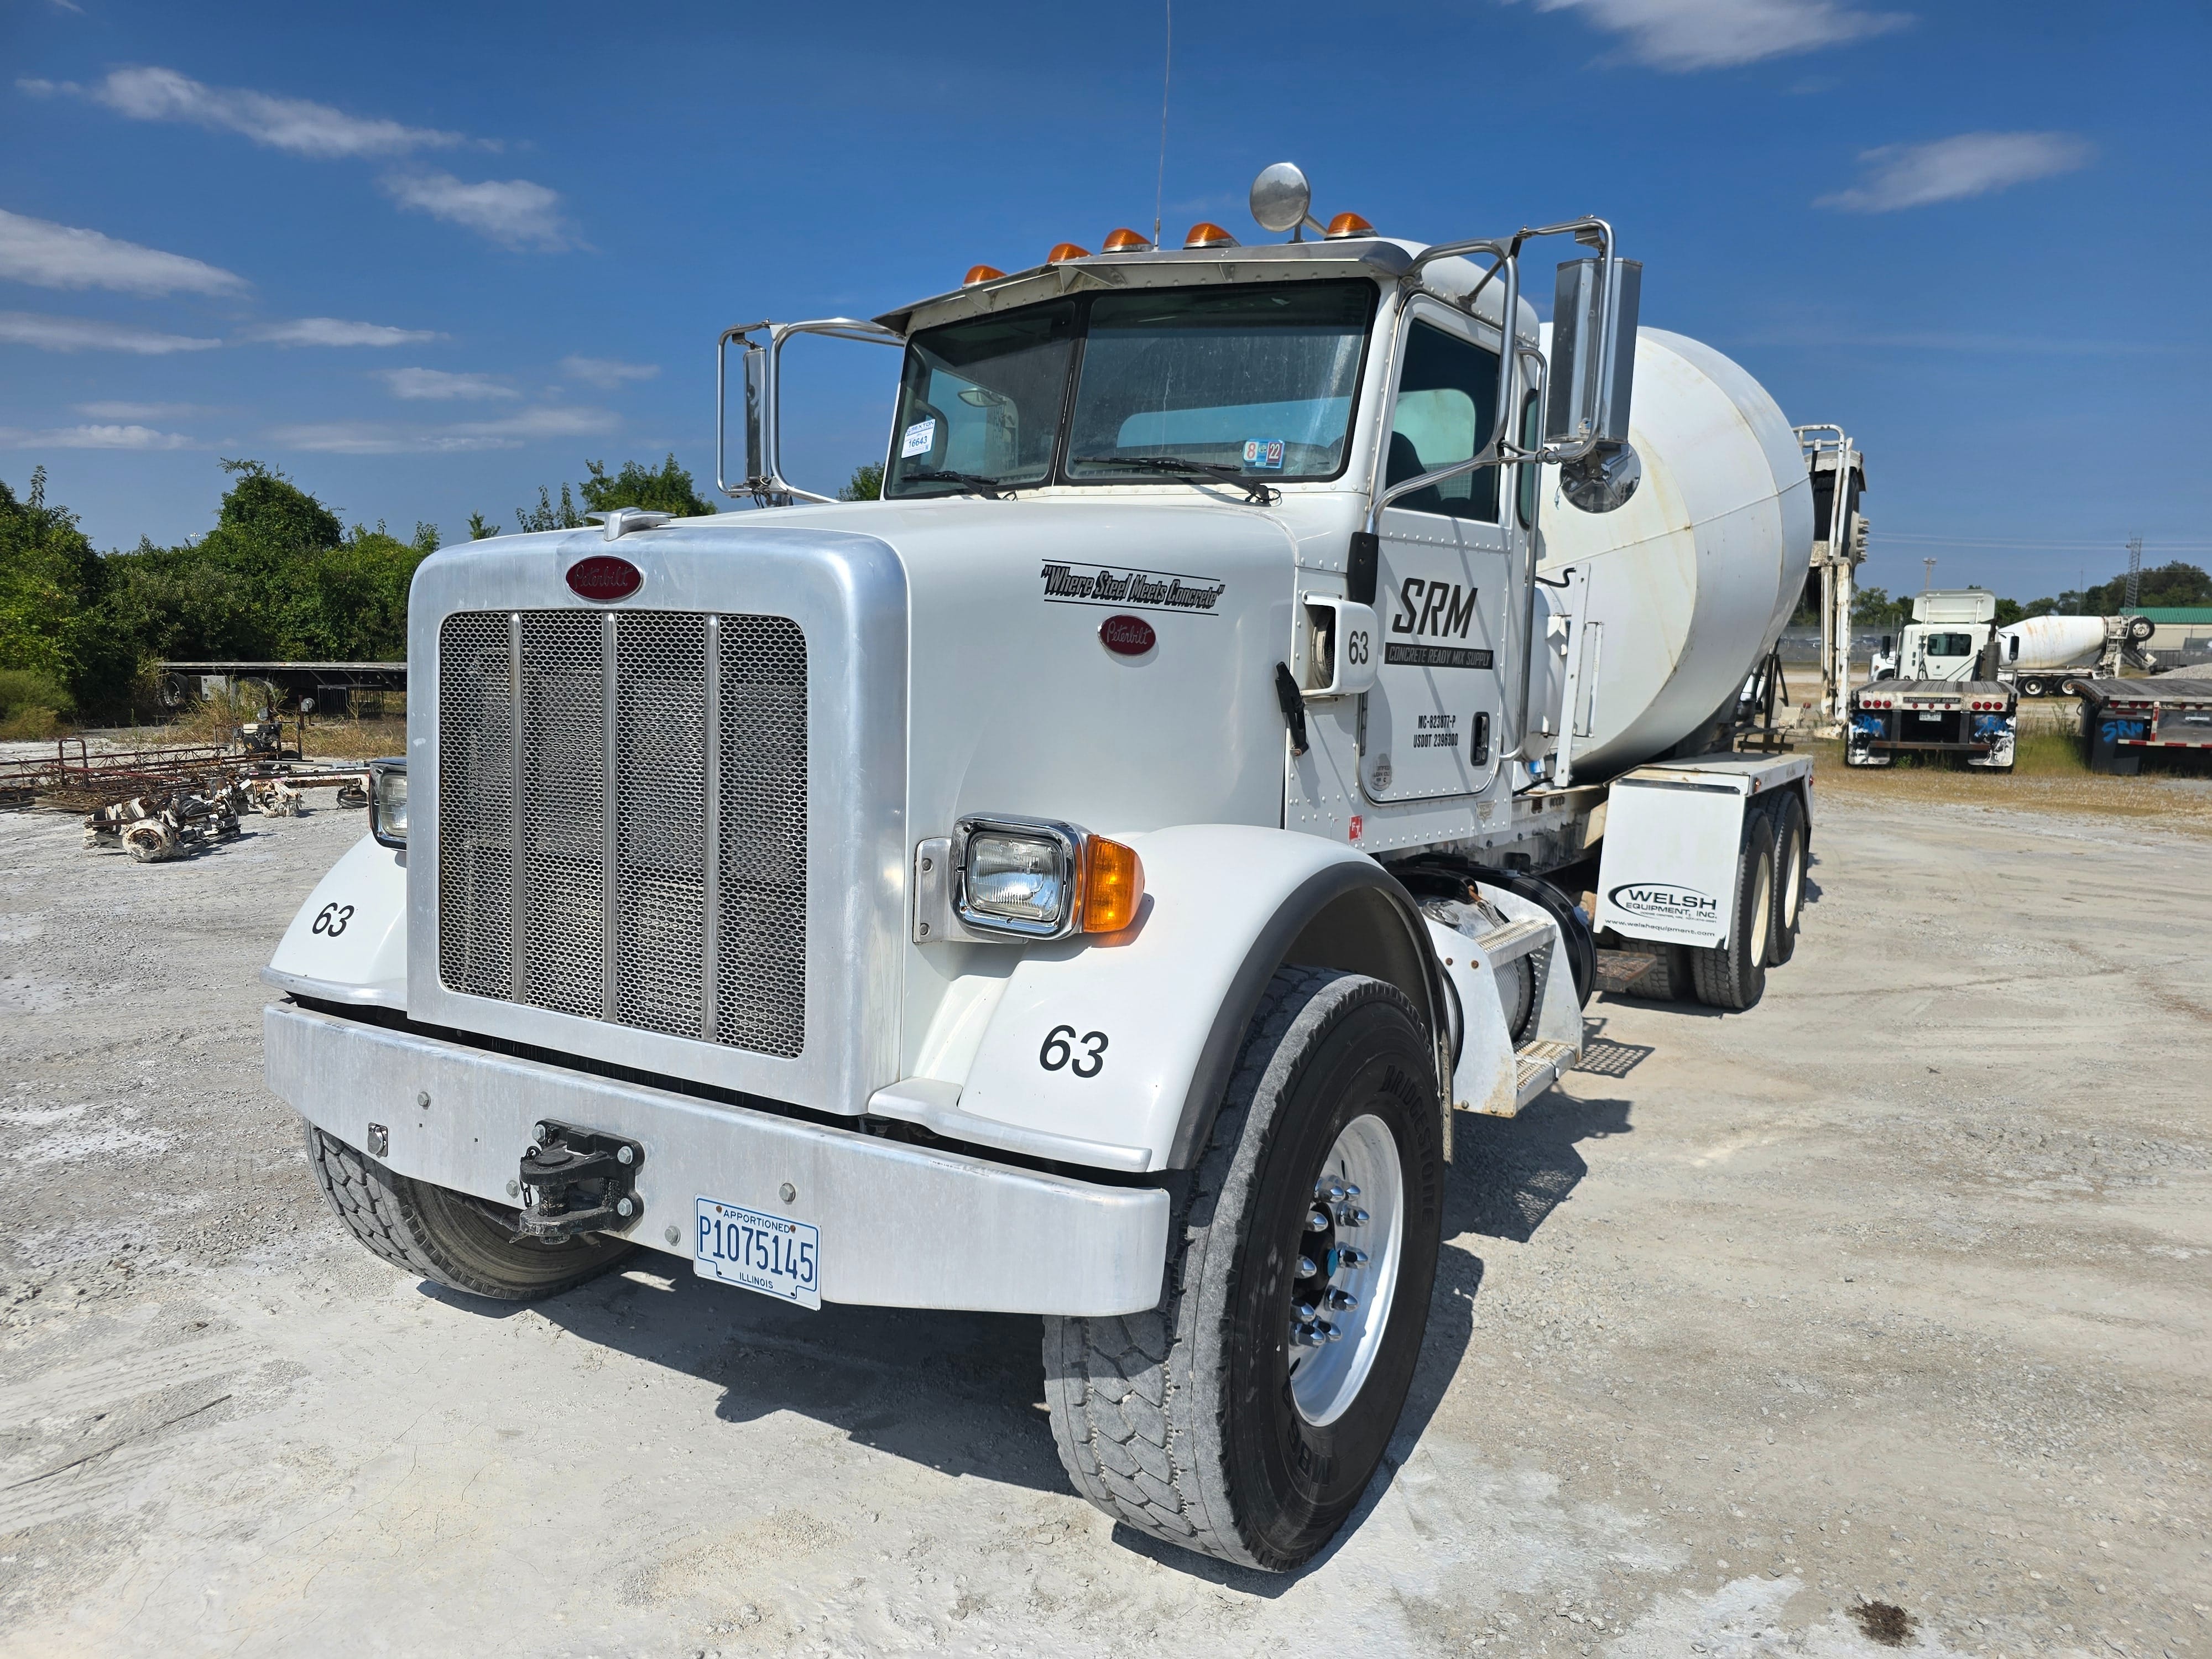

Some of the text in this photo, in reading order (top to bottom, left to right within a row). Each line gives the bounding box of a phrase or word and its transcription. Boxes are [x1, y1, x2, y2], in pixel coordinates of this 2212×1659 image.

[911, 421, 933, 431] SEXTON
[909, 436, 927, 448] 16643
[1247, 442, 1256, 460] 8
[1269, 444, 1280, 459] 22
[575, 564, 634, 589] Peterbilt
[1041, 564, 1225, 609] "Where Steel Meets Concrete"
[1392, 578, 1478, 638] SRM
[1106, 620, 1152, 645] Peterbilt
[1349, 630, 1368, 665] 63
[1388, 646, 1490, 666] CONCRETE READY MIX SUPPLY
[1418, 715, 1455, 729] MC-823877-P
[1974, 714, 2009, 737] SRM
[2101, 719, 2143, 743] SRM
[1413, 733, 1458, 748] USDOT 2396300
[1626, 902, 1691, 917] EQUIPMENT,
[1628, 889, 1717, 910] WELSH
[312, 902, 354, 937] 63
[1604, 919, 1715, 936] www.welshequipment.com
[1040, 1025, 1108, 1078] 63
[1378, 1064, 1434, 1223] BRIDGESTONE
[723, 1210, 790, 1233] APPORTIONED
[700, 1215, 813, 1282] P1075145
[739, 1272, 773, 1288] ILLINOIS
